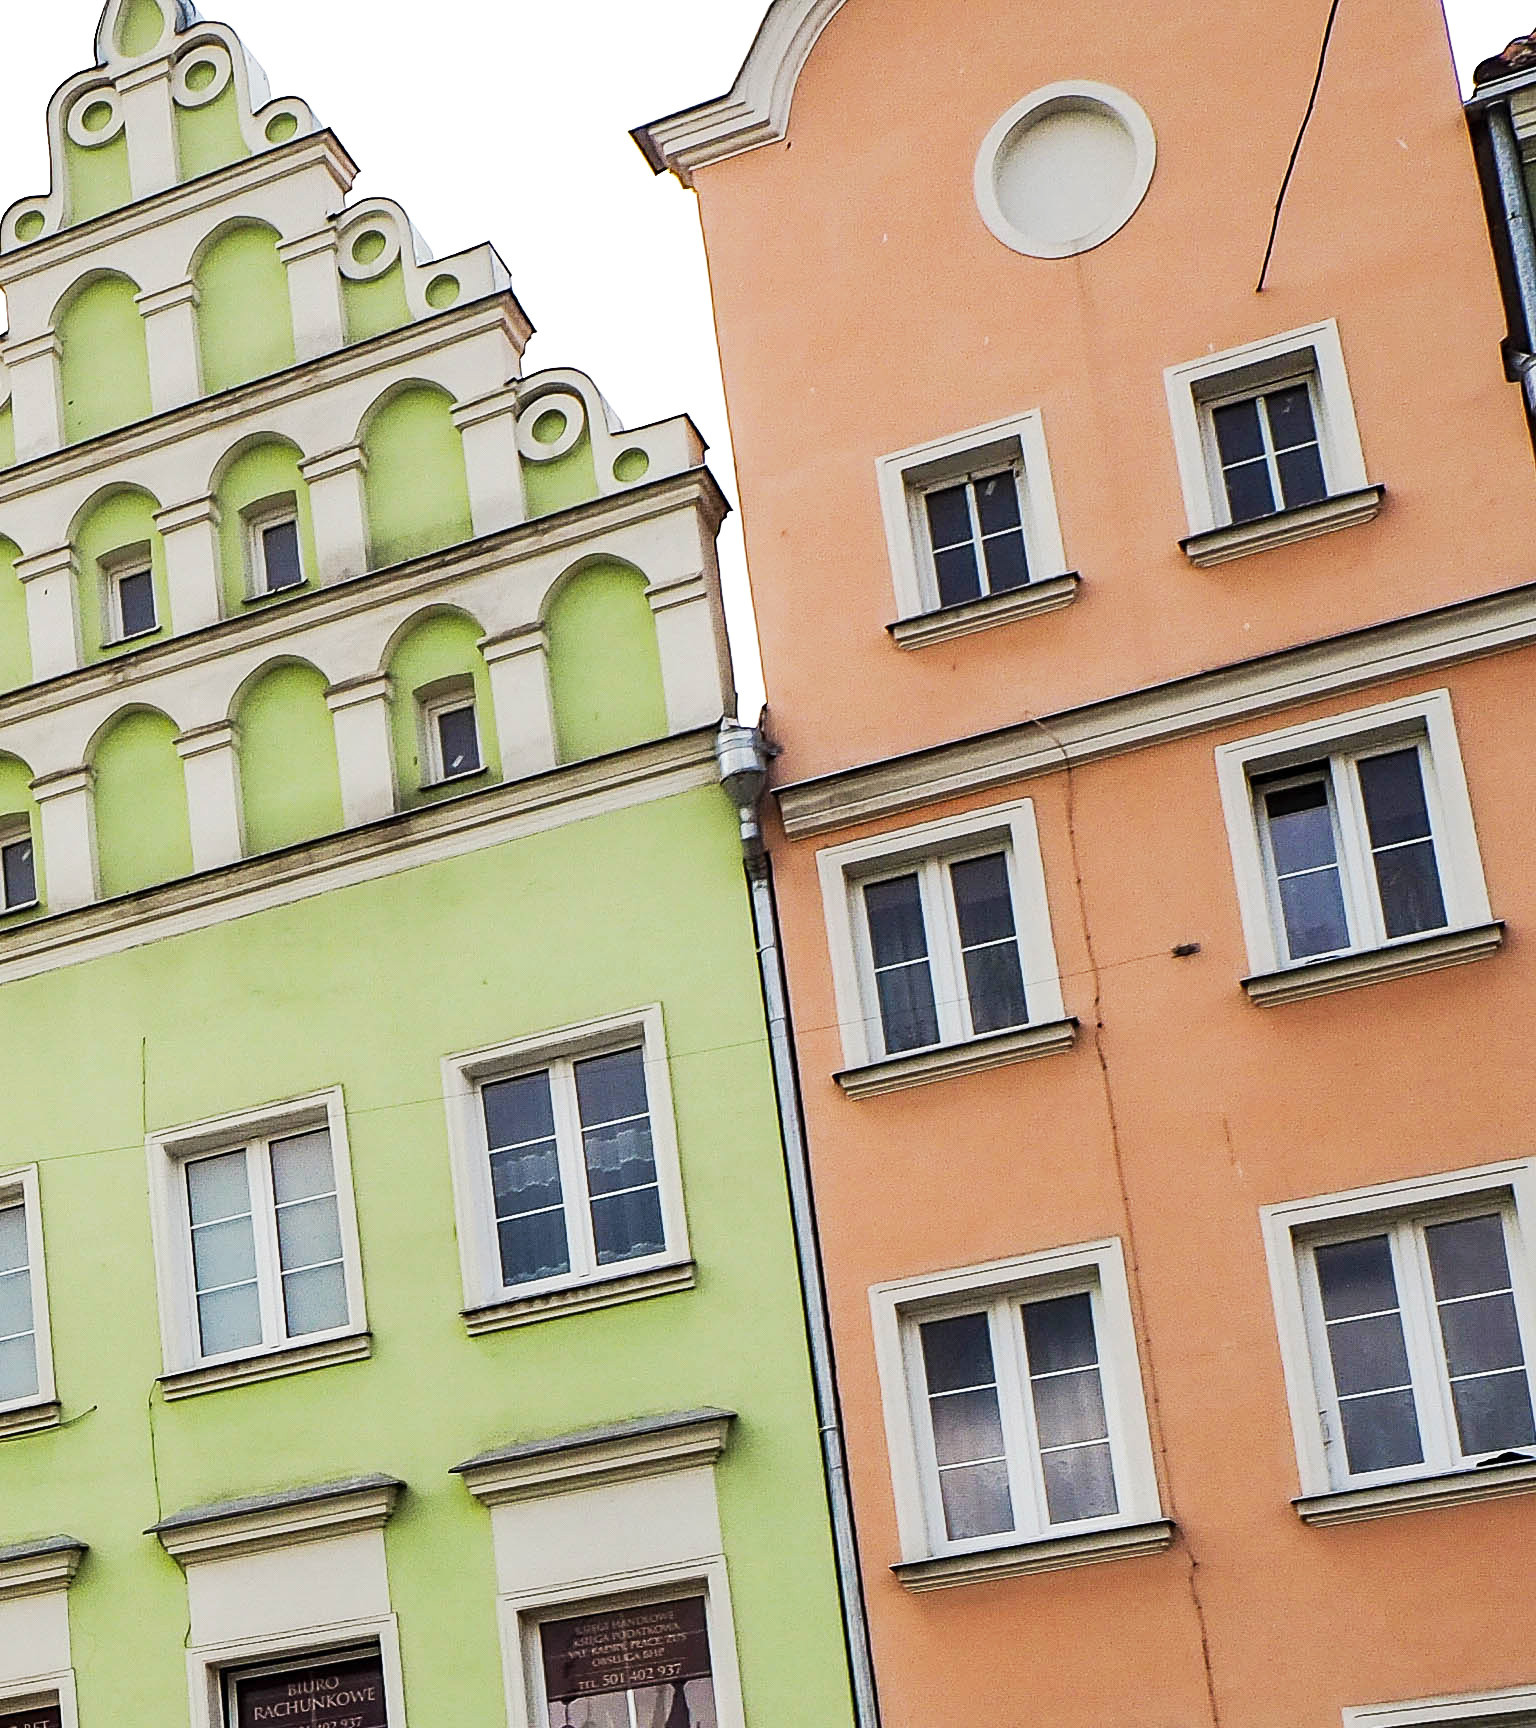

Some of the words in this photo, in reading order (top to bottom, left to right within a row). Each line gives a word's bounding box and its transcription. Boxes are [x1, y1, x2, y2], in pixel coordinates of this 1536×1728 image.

[288, 1675, 340, 1697] BIURO
[602, 1674, 625, 1687] 501
[629, 1667, 655, 1683] 402
[657, 1663, 681, 1676] 937
[254, 1686, 376, 1721] RACHUNKOWE
